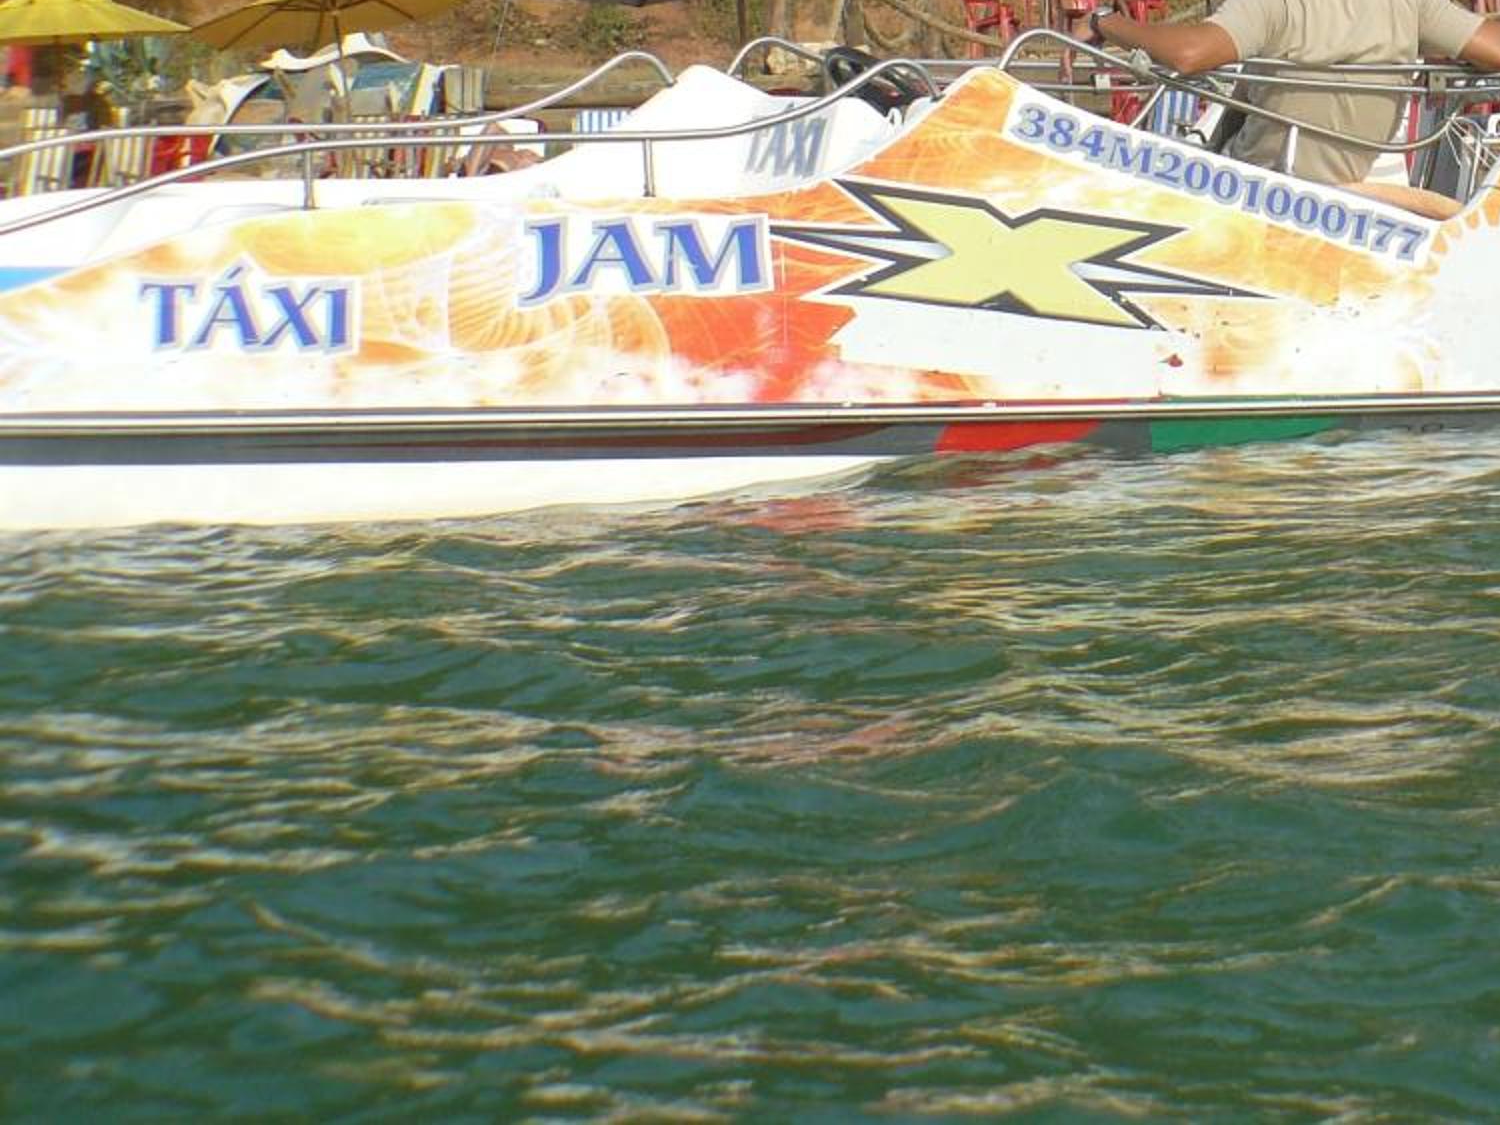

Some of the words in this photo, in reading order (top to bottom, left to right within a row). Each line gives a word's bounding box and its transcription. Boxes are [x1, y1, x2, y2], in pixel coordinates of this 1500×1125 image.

[1012, 103, 1428, 260] 384M2001000177
[138, 262, 352, 351] TÁXI
[517, 218, 769, 304] JAM
